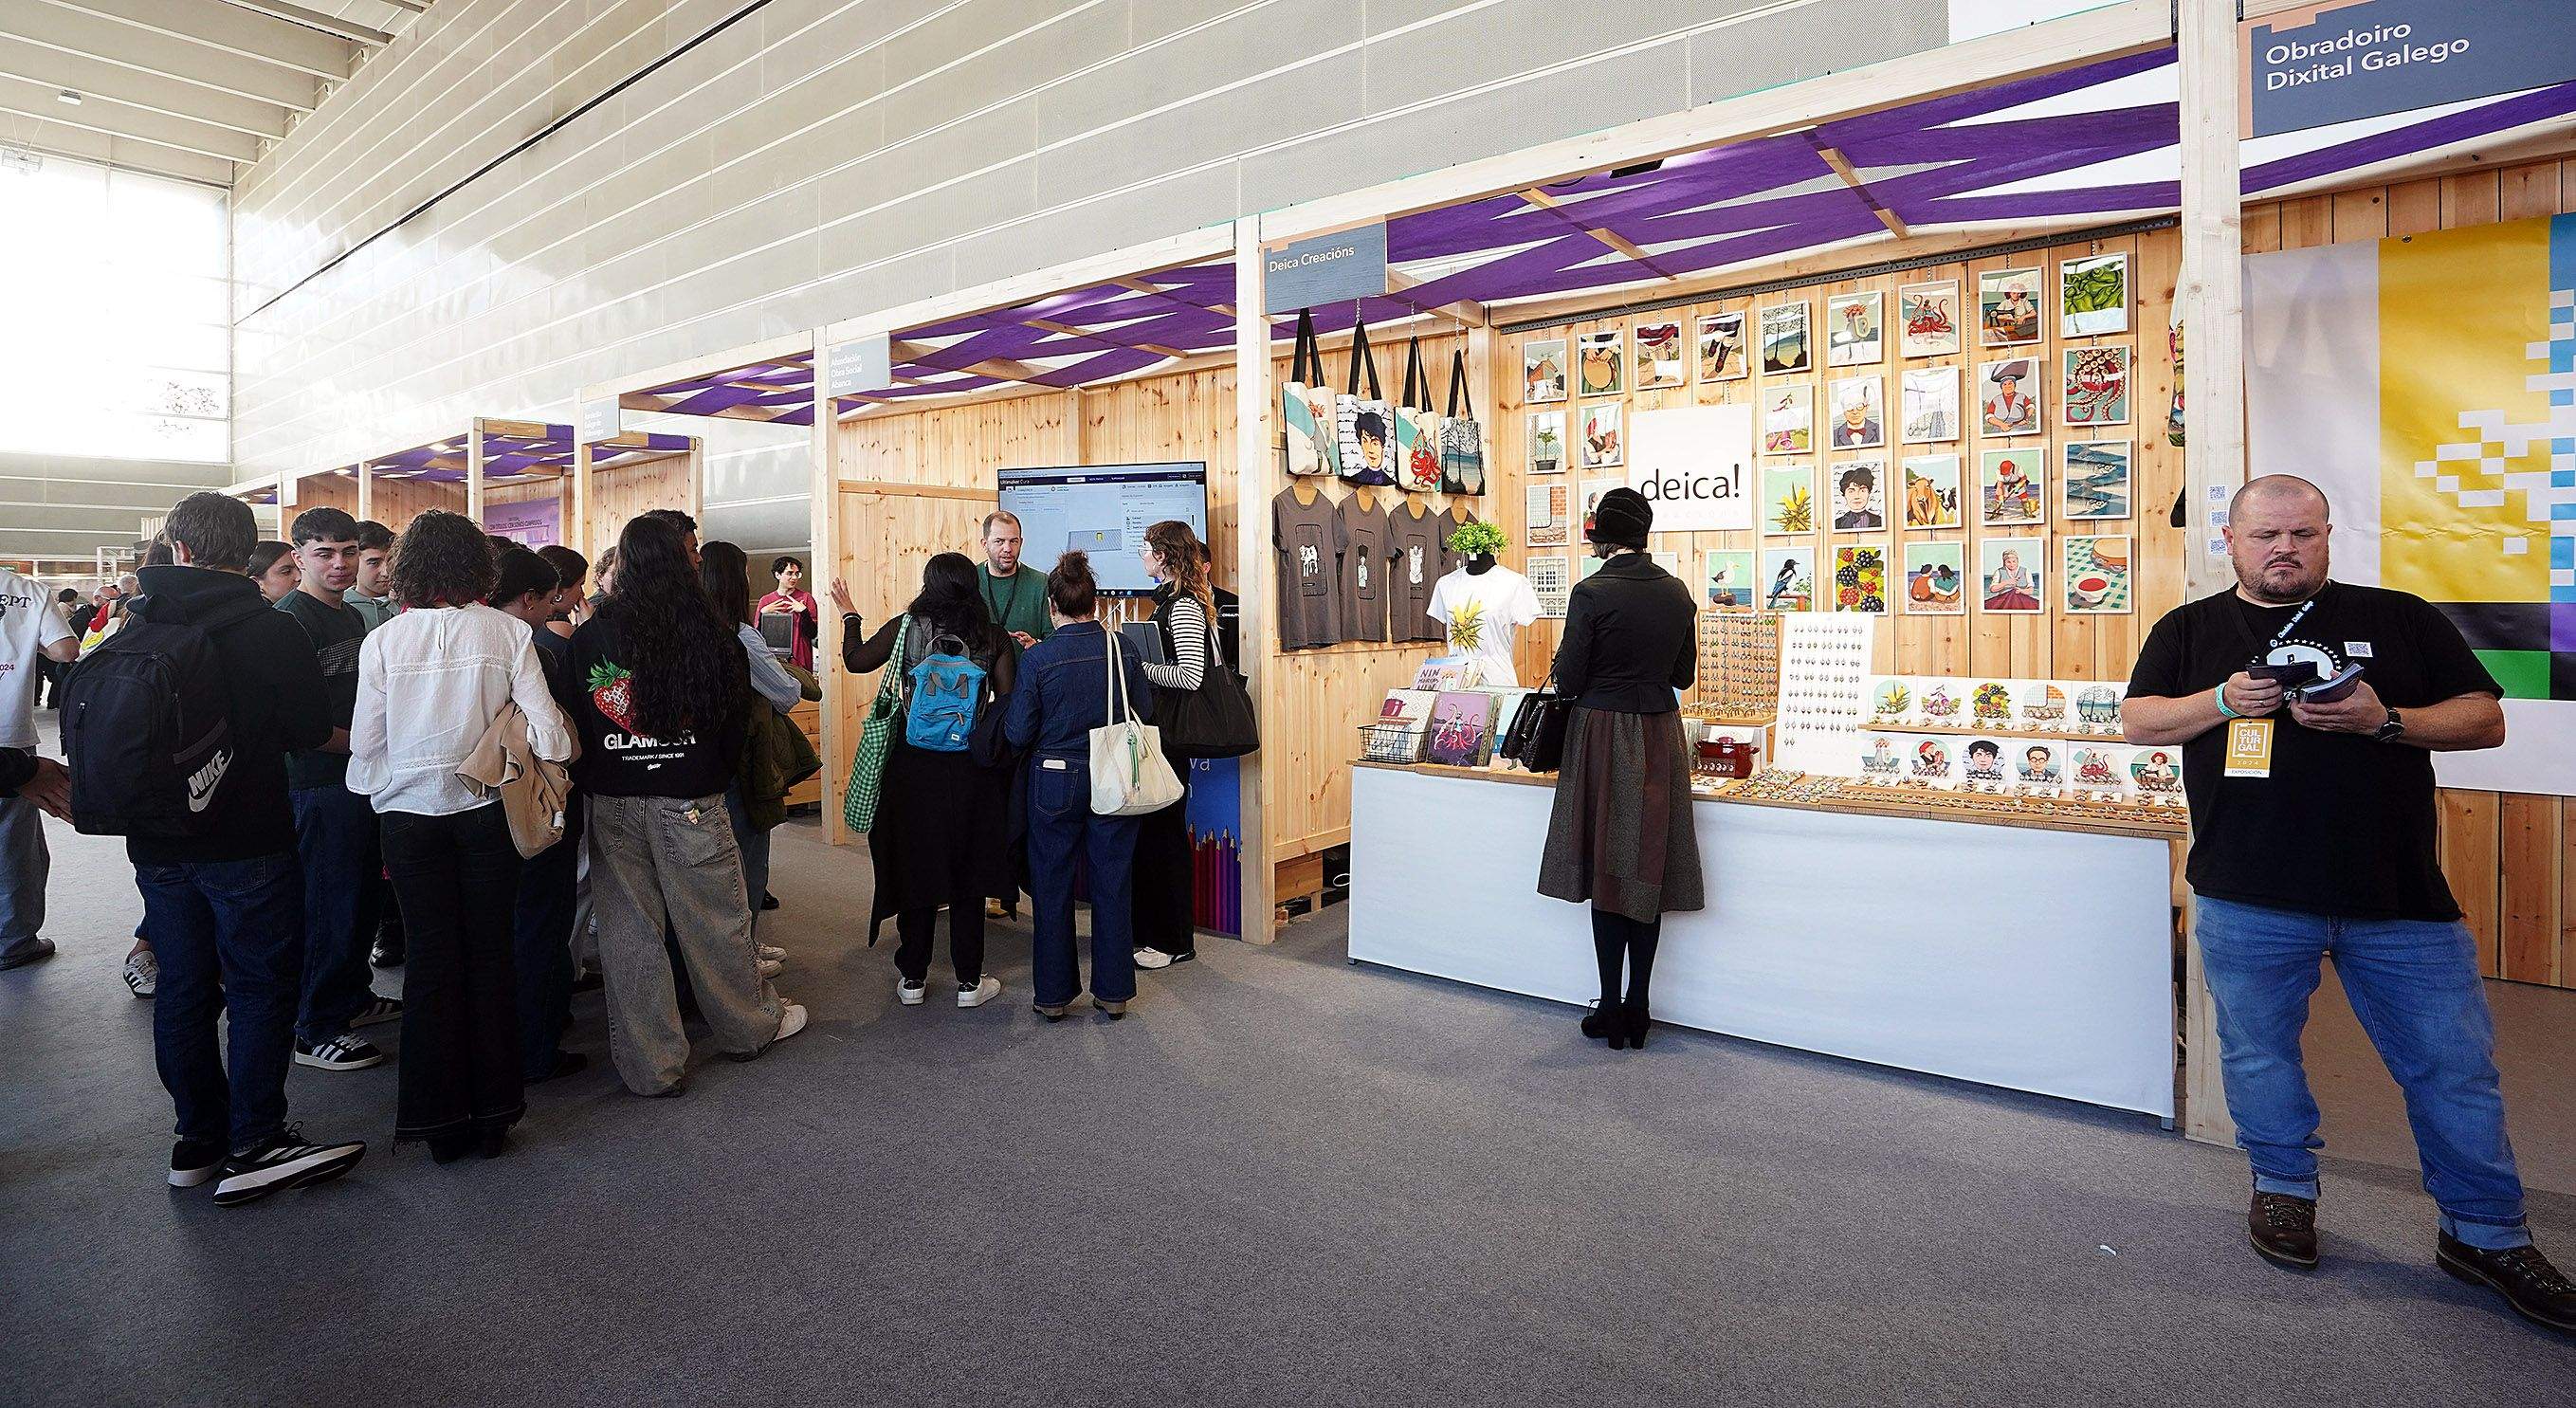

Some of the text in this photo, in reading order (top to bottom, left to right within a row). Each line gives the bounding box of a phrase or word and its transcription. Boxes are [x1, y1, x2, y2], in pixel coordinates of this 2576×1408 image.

[2265, 24, 2412, 64] Obradoiro
[2266, 38, 2470, 91] Dixital Galego
[1270, 245, 1355, 273] Deica Creacións
[1640, 463, 1740, 502] deica!
[2238, 728, 2259, 737] CUL
[2238, 735, 2261, 744] TUR
[2238, 743, 2260, 752] GAL
[188, 749, 228, 797] NIKE
